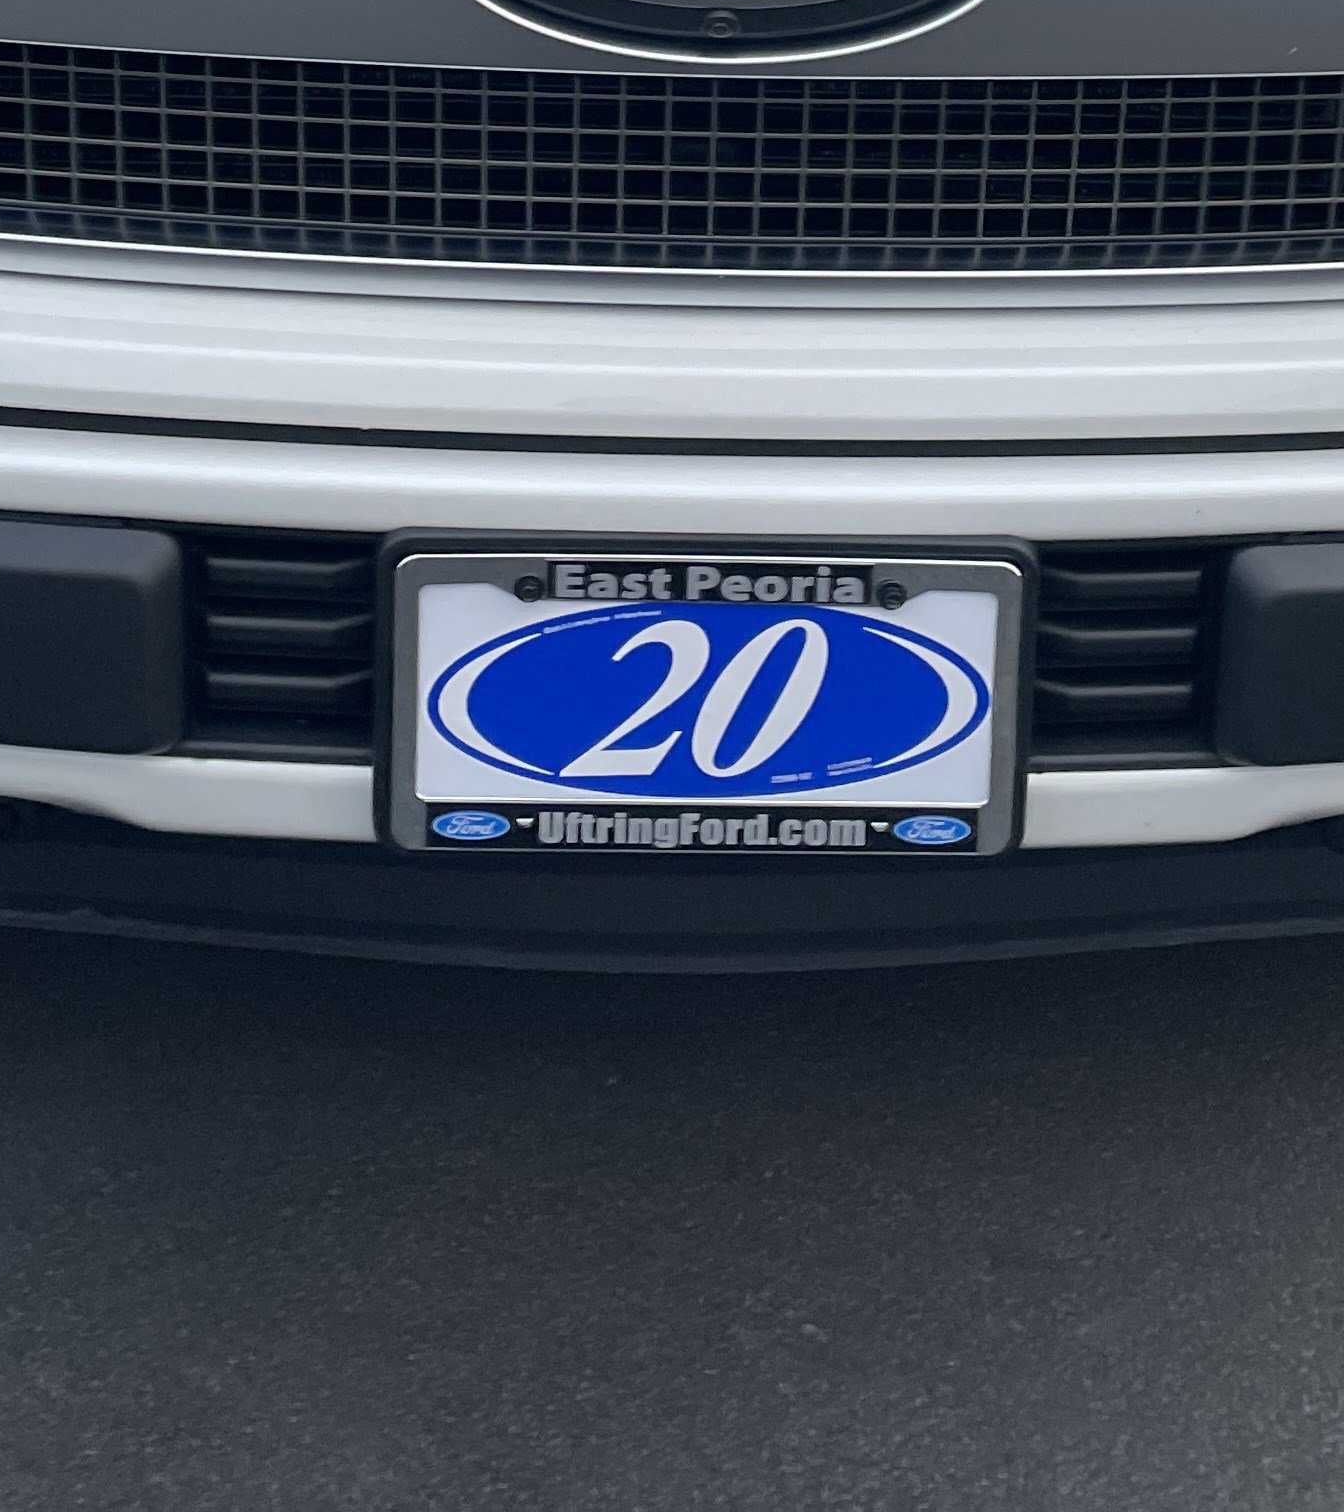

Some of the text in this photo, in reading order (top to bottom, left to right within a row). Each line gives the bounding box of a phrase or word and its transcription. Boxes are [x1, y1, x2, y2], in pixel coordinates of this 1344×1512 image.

[555, 563, 865, 603] East Peoria
[558, 617, 830, 779] 20
[446, 815, 496, 836] Ford
[537, 810, 867, 849] UftringFord.com
[906, 818, 958, 840] Ford
